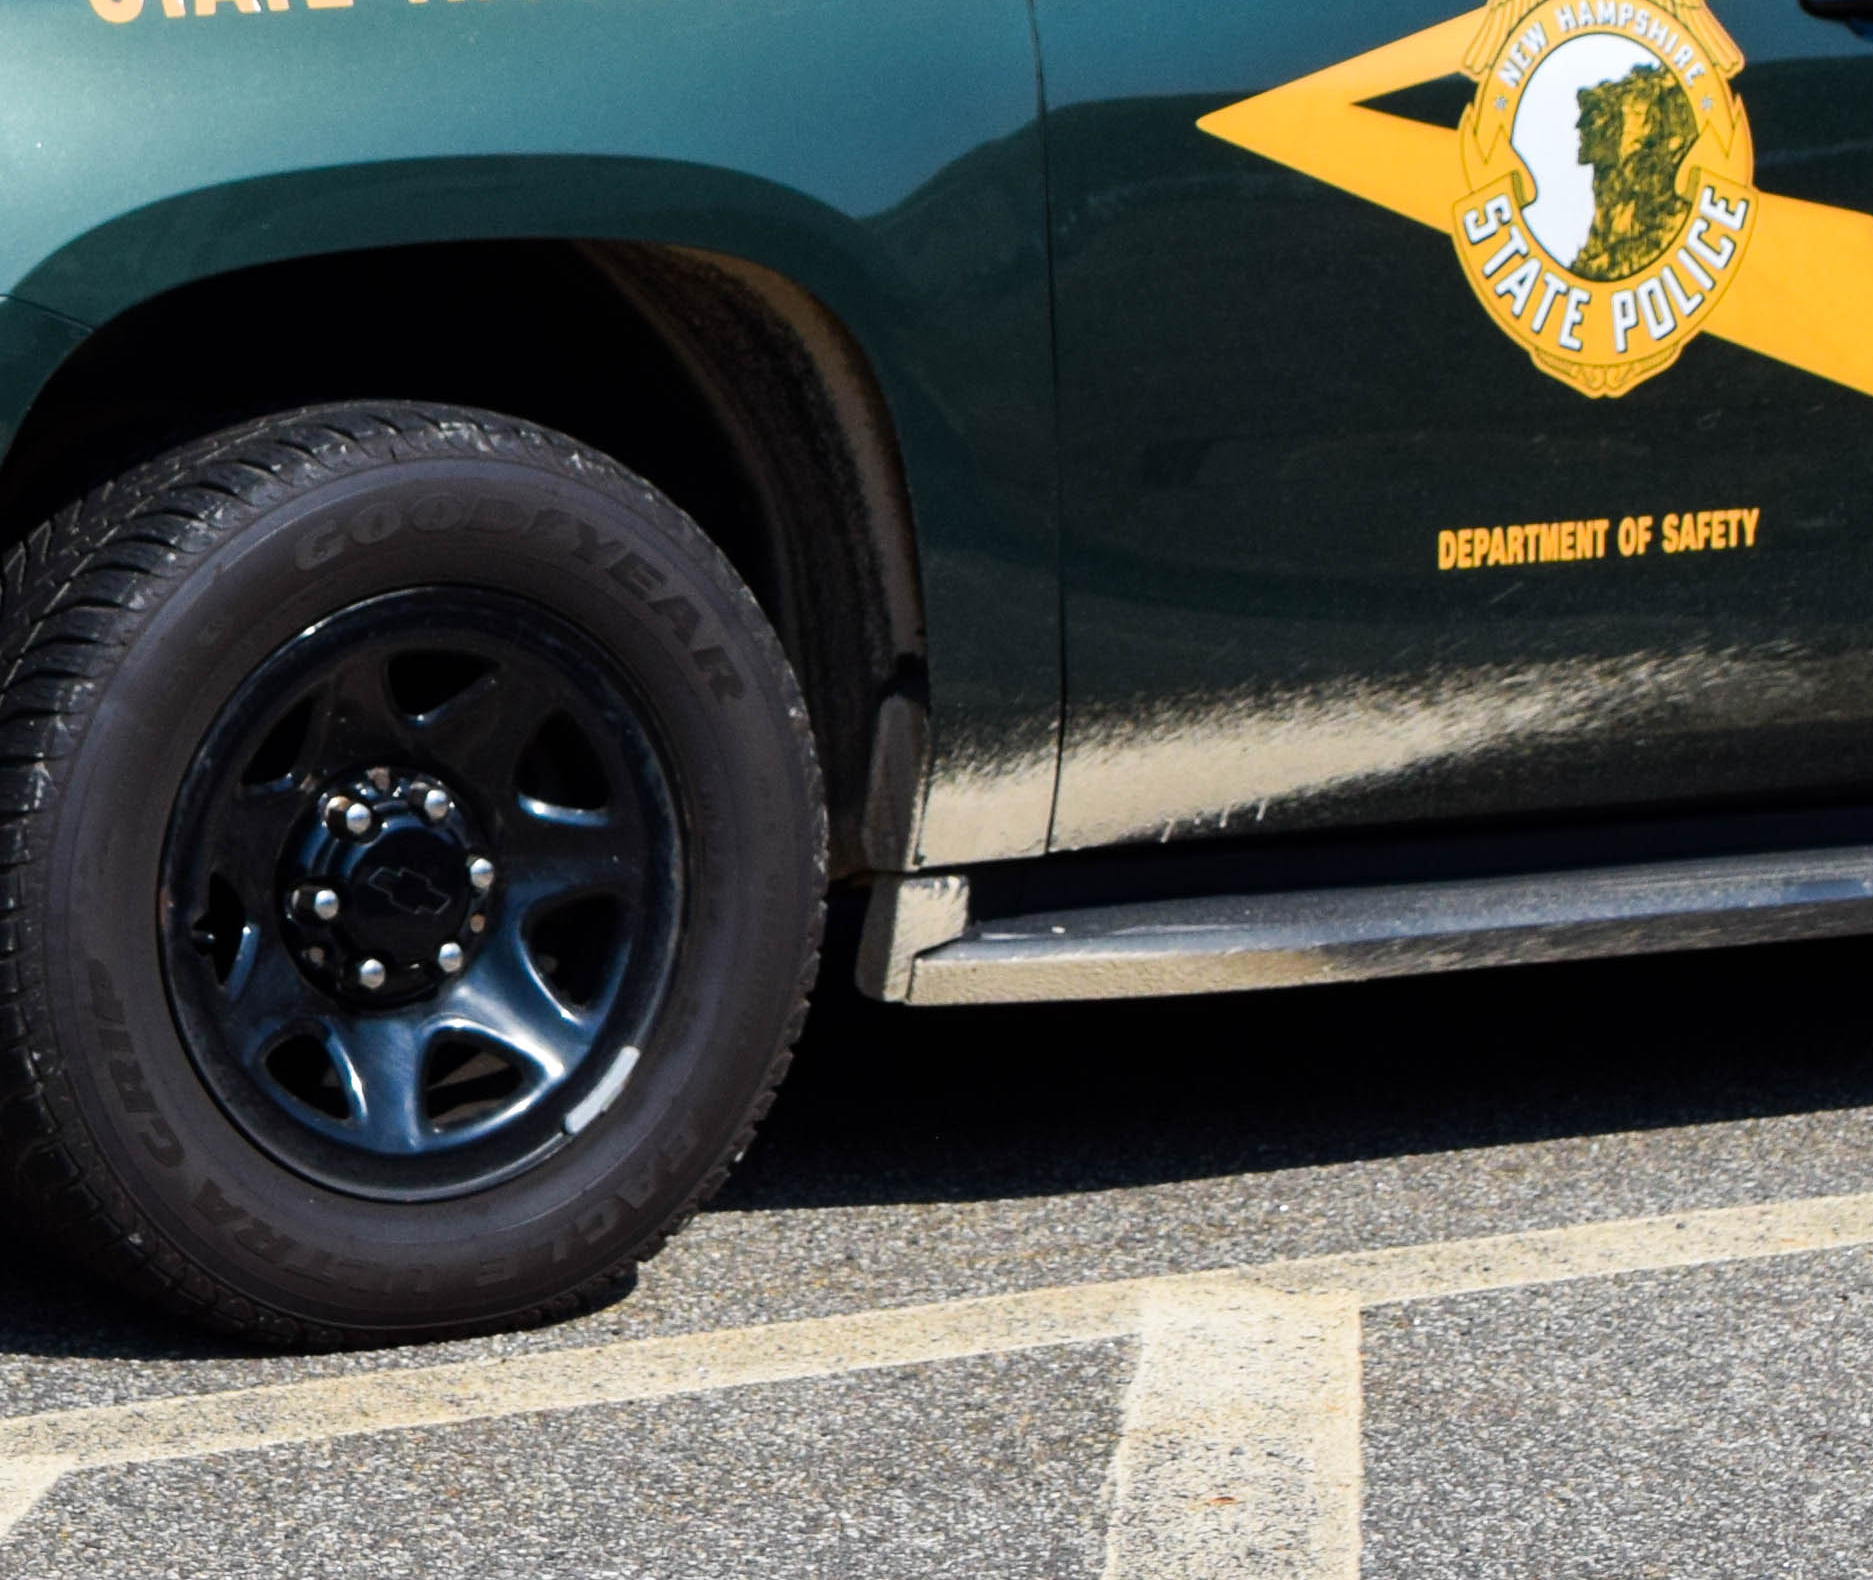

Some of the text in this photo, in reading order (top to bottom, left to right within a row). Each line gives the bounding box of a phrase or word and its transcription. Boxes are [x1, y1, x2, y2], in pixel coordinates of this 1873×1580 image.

[1496, 18, 1552, 91] NEW
[1463, 183, 1750, 355] STATE POLICE
[294, 492, 745, 704] GOODYEAR
[1438, 507, 1761, 570] DEPARTMENT OF SAFETY
